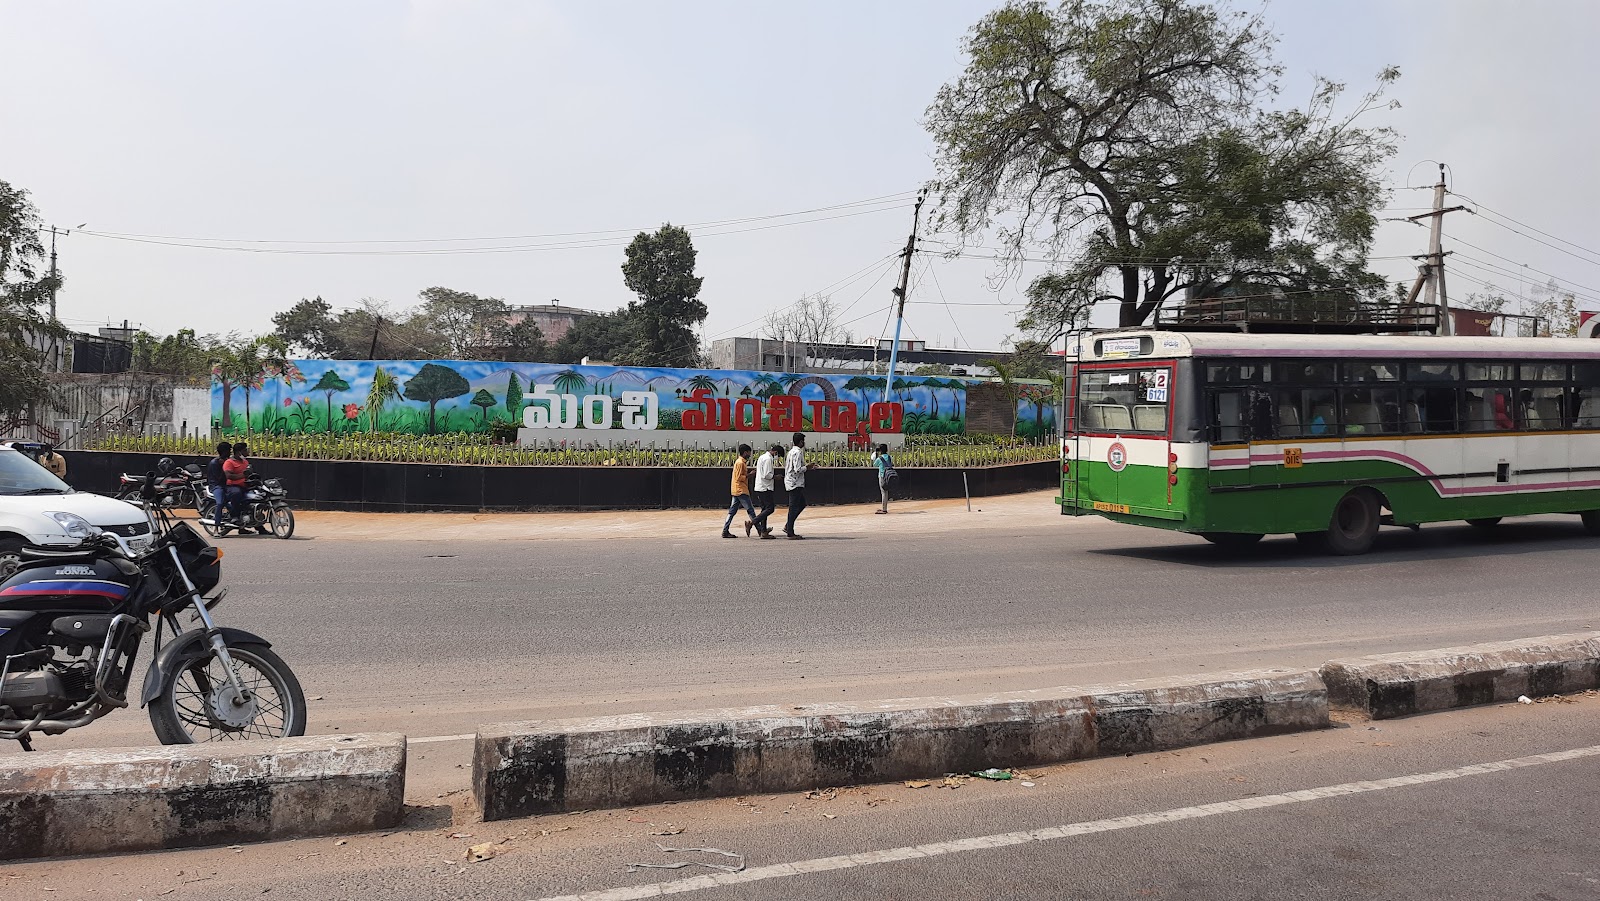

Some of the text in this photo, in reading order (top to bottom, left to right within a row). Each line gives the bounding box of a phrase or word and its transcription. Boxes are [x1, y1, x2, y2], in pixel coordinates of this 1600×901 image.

[1157, 375, 1166, 387] 2
[1148, 389, 1165, 400] 6121
[522, 384, 902, 448] మంచి మంచిర్యాల
